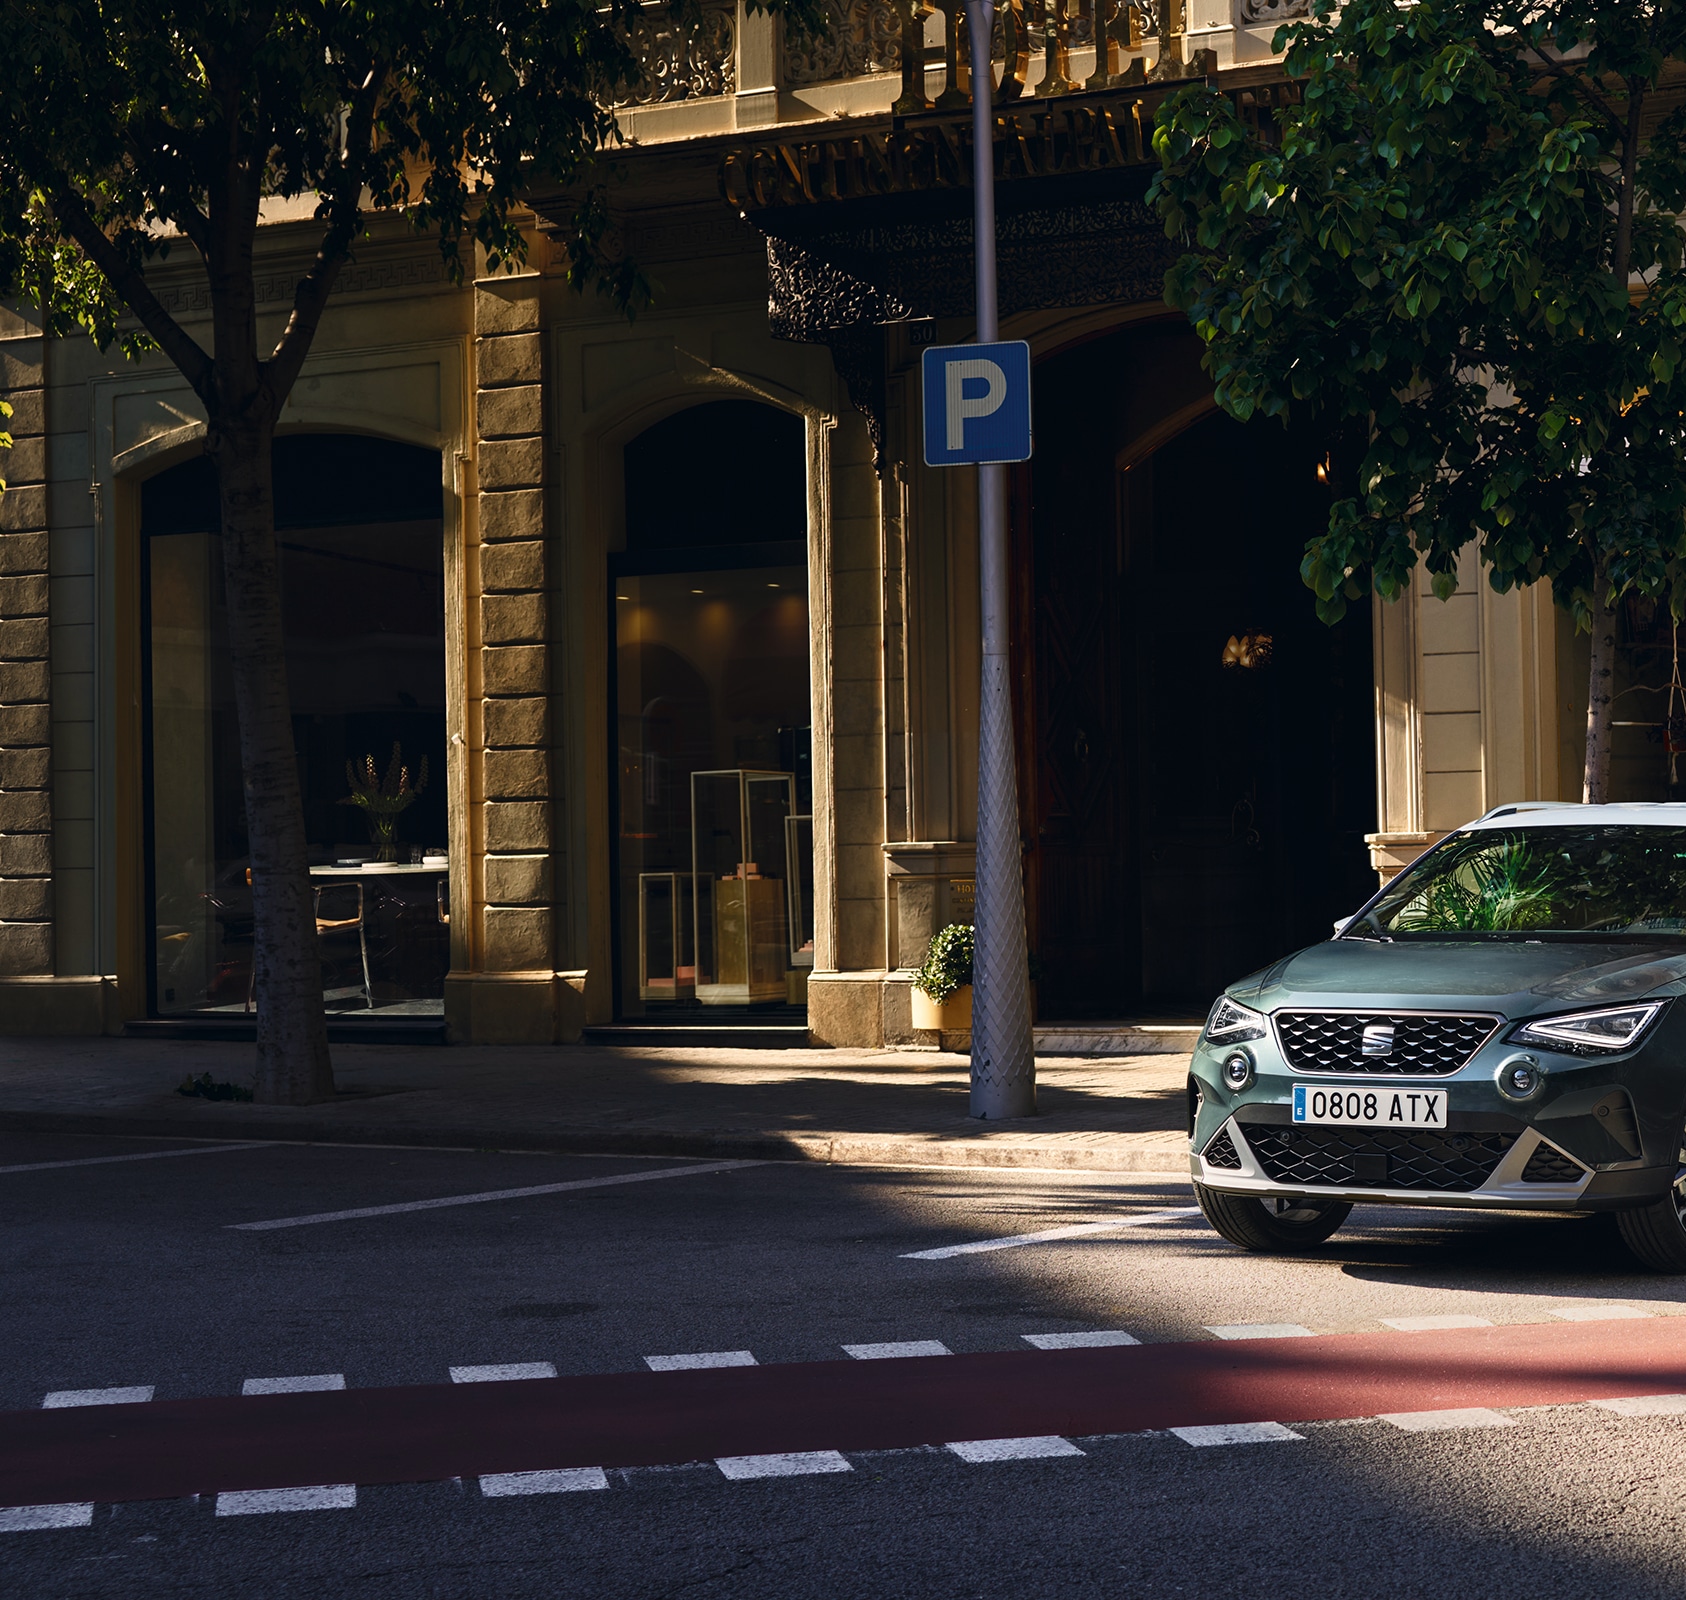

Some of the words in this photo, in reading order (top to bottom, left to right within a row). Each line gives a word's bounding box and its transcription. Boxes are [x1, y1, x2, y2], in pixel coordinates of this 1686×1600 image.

[717, 111, 1064, 209] CONTINENAL
[912, 324, 933, 342] 30
[945, 358, 1008, 451] P
[1312, 1091, 1378, 1120] 0808
[1388, 1093, 1439, 1123] ATX
